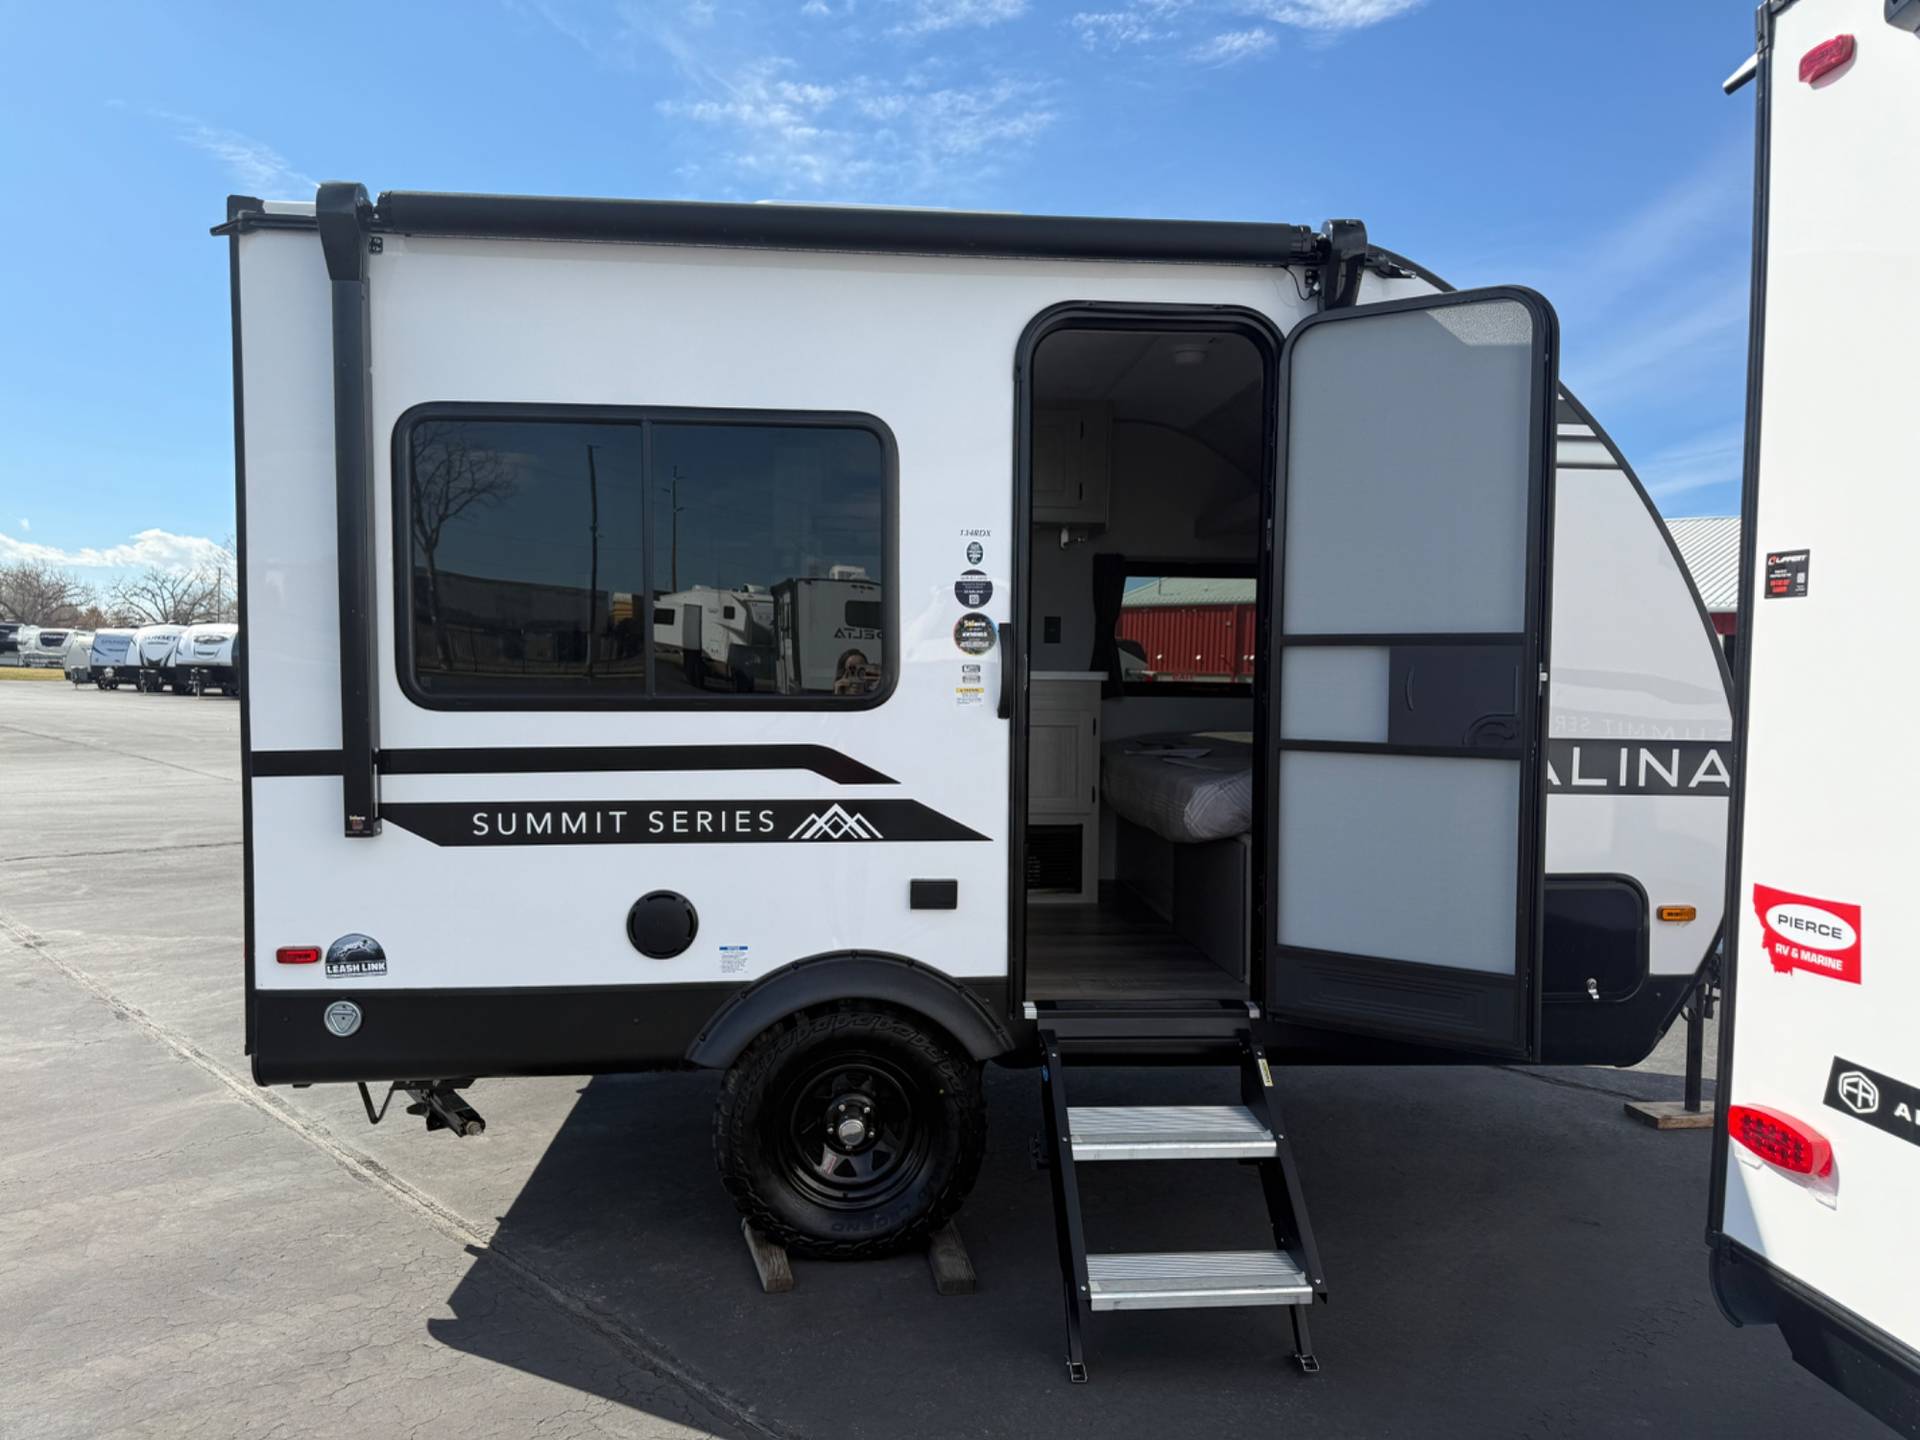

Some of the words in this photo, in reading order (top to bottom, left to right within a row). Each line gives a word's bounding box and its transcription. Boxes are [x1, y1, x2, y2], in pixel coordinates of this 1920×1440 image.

[472, 810, 628, 836] SUMMIT
[648, 809, 775, 834] SERIES
[1777, 913, 1843, 940] PIERCE
[327, 964, 360, 974] LEASH
[361, 962, 386, 972] LINK
[1775, 943, 1789, 957] RV
[1791, 947, 1799, 959] &
[1800, 949, 1844, 972] MARINE
